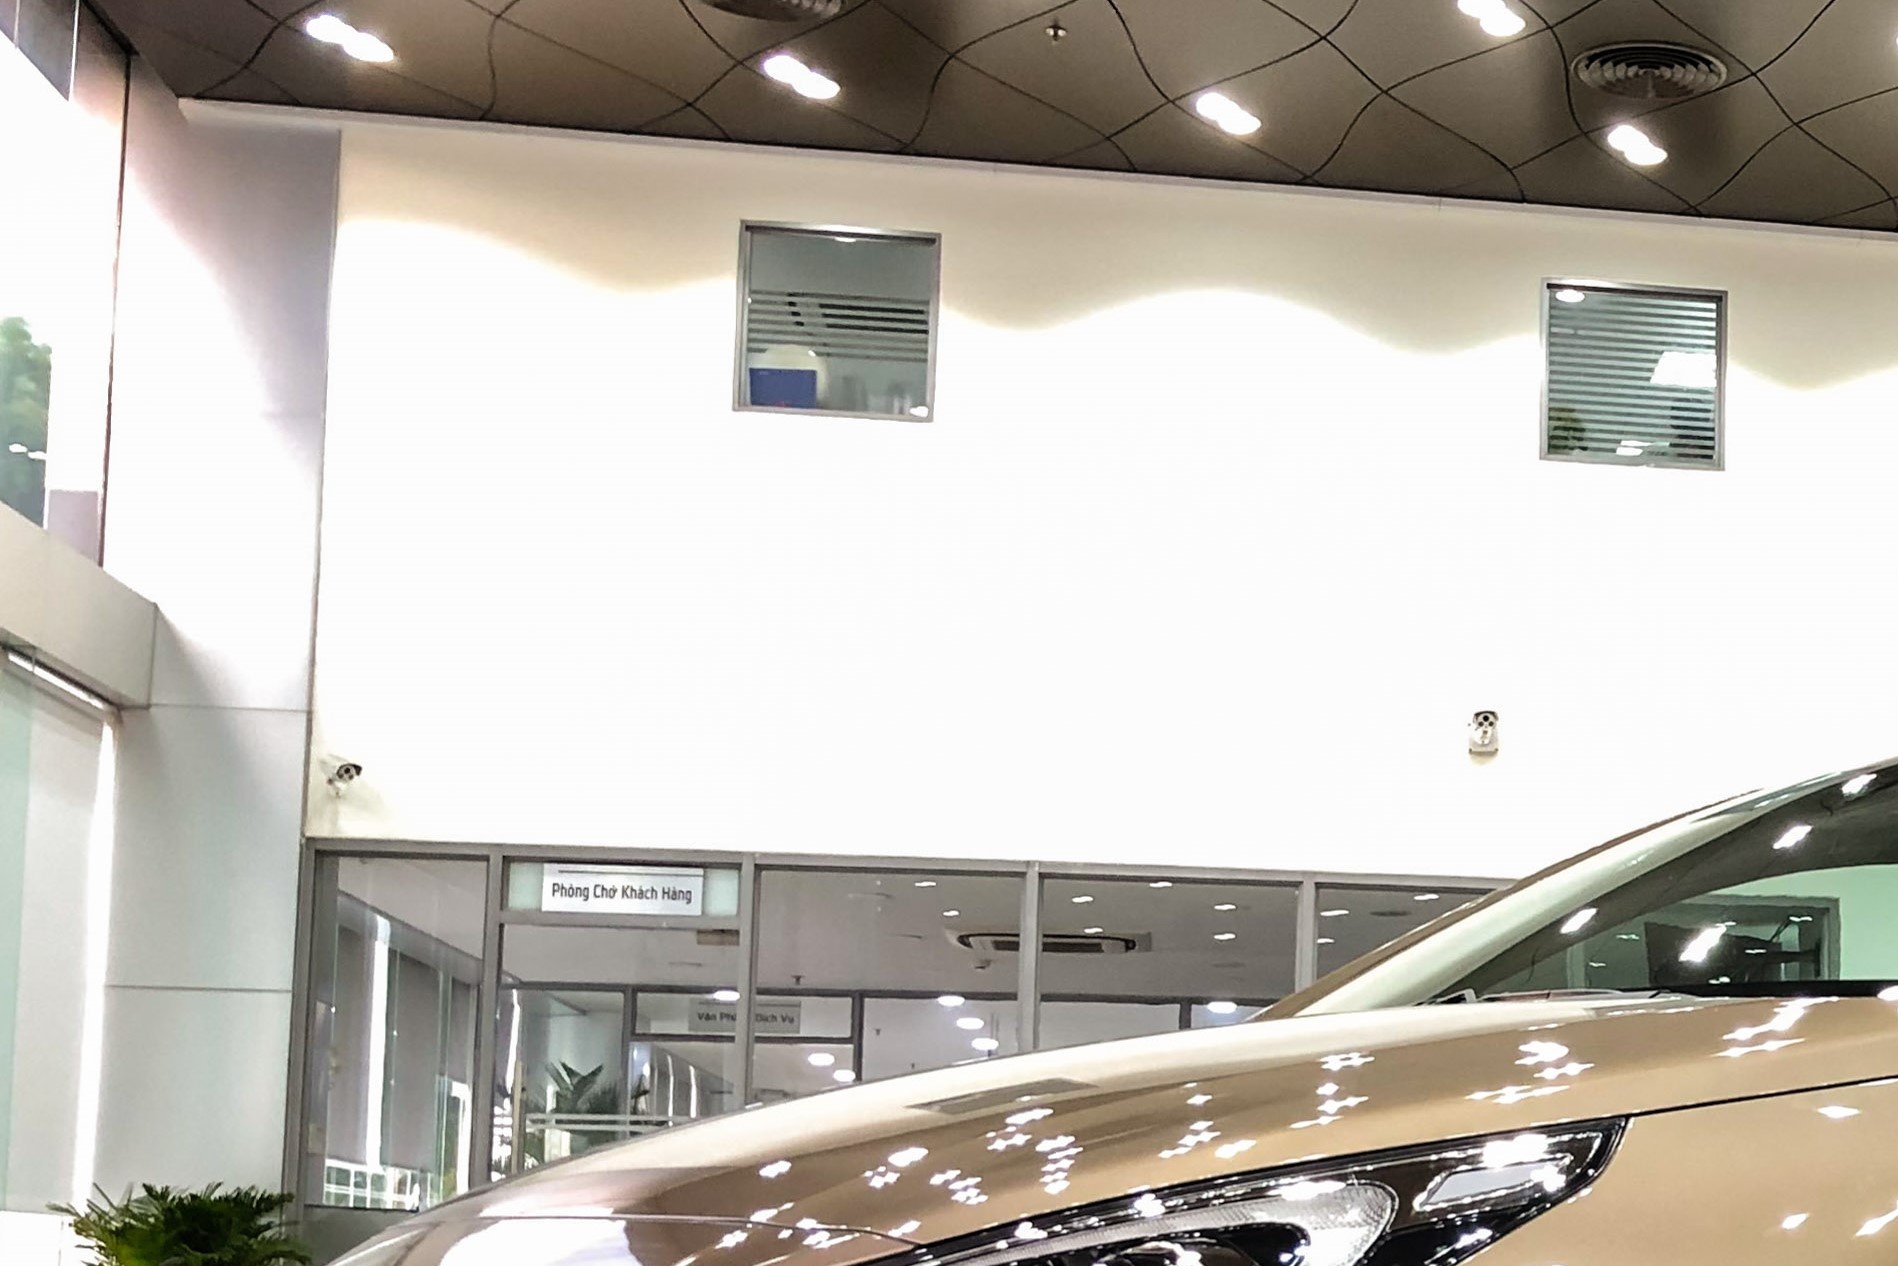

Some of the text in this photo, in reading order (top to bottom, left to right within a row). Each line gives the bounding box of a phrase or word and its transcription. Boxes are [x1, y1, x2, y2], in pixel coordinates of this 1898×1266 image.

[552, 882, 693, 905] Phòng Chờ Khách Hàng
